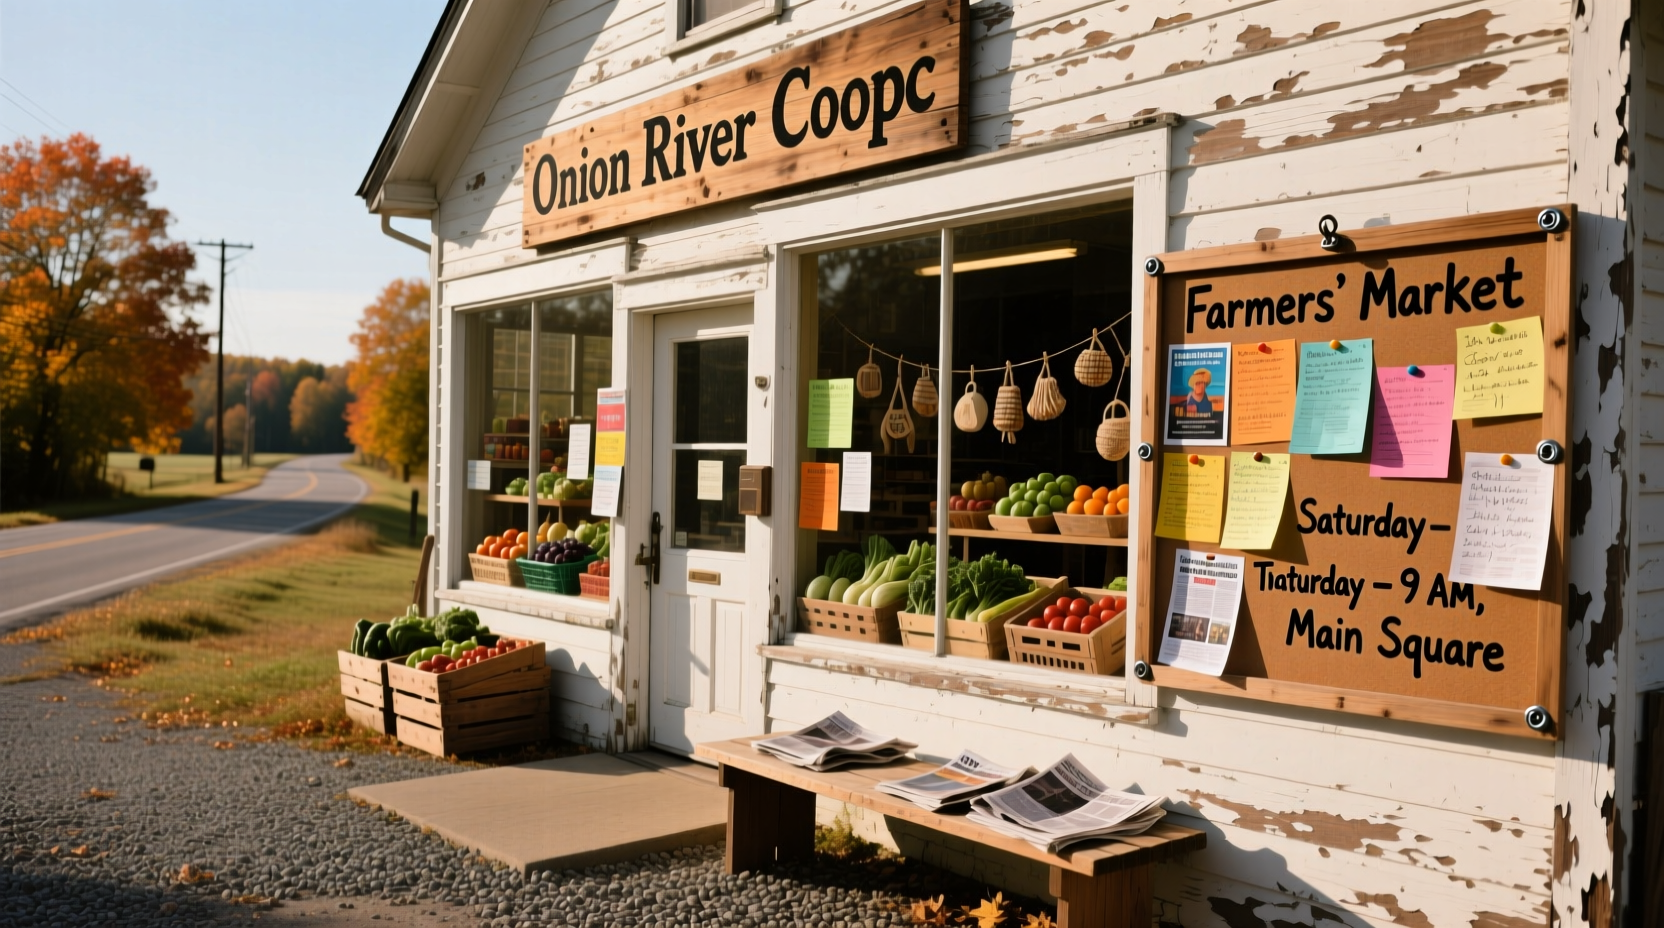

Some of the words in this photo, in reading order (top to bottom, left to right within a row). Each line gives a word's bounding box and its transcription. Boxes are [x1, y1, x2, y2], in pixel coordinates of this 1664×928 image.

[532, 147, 631, 216] Onion
[641, 110, 757, 187] River
[771, 55, 937, 149] Coopc
[1186, 272, 1346, 334] Farmers’
[1359, 256, 1526, 321] Market
[1400, 567, 1421, 604] 9
[1426, 572, 1485, 616] AM,
[1285, 607, 1363, 654] Main
[1377, 615, 1506, 679] Square
